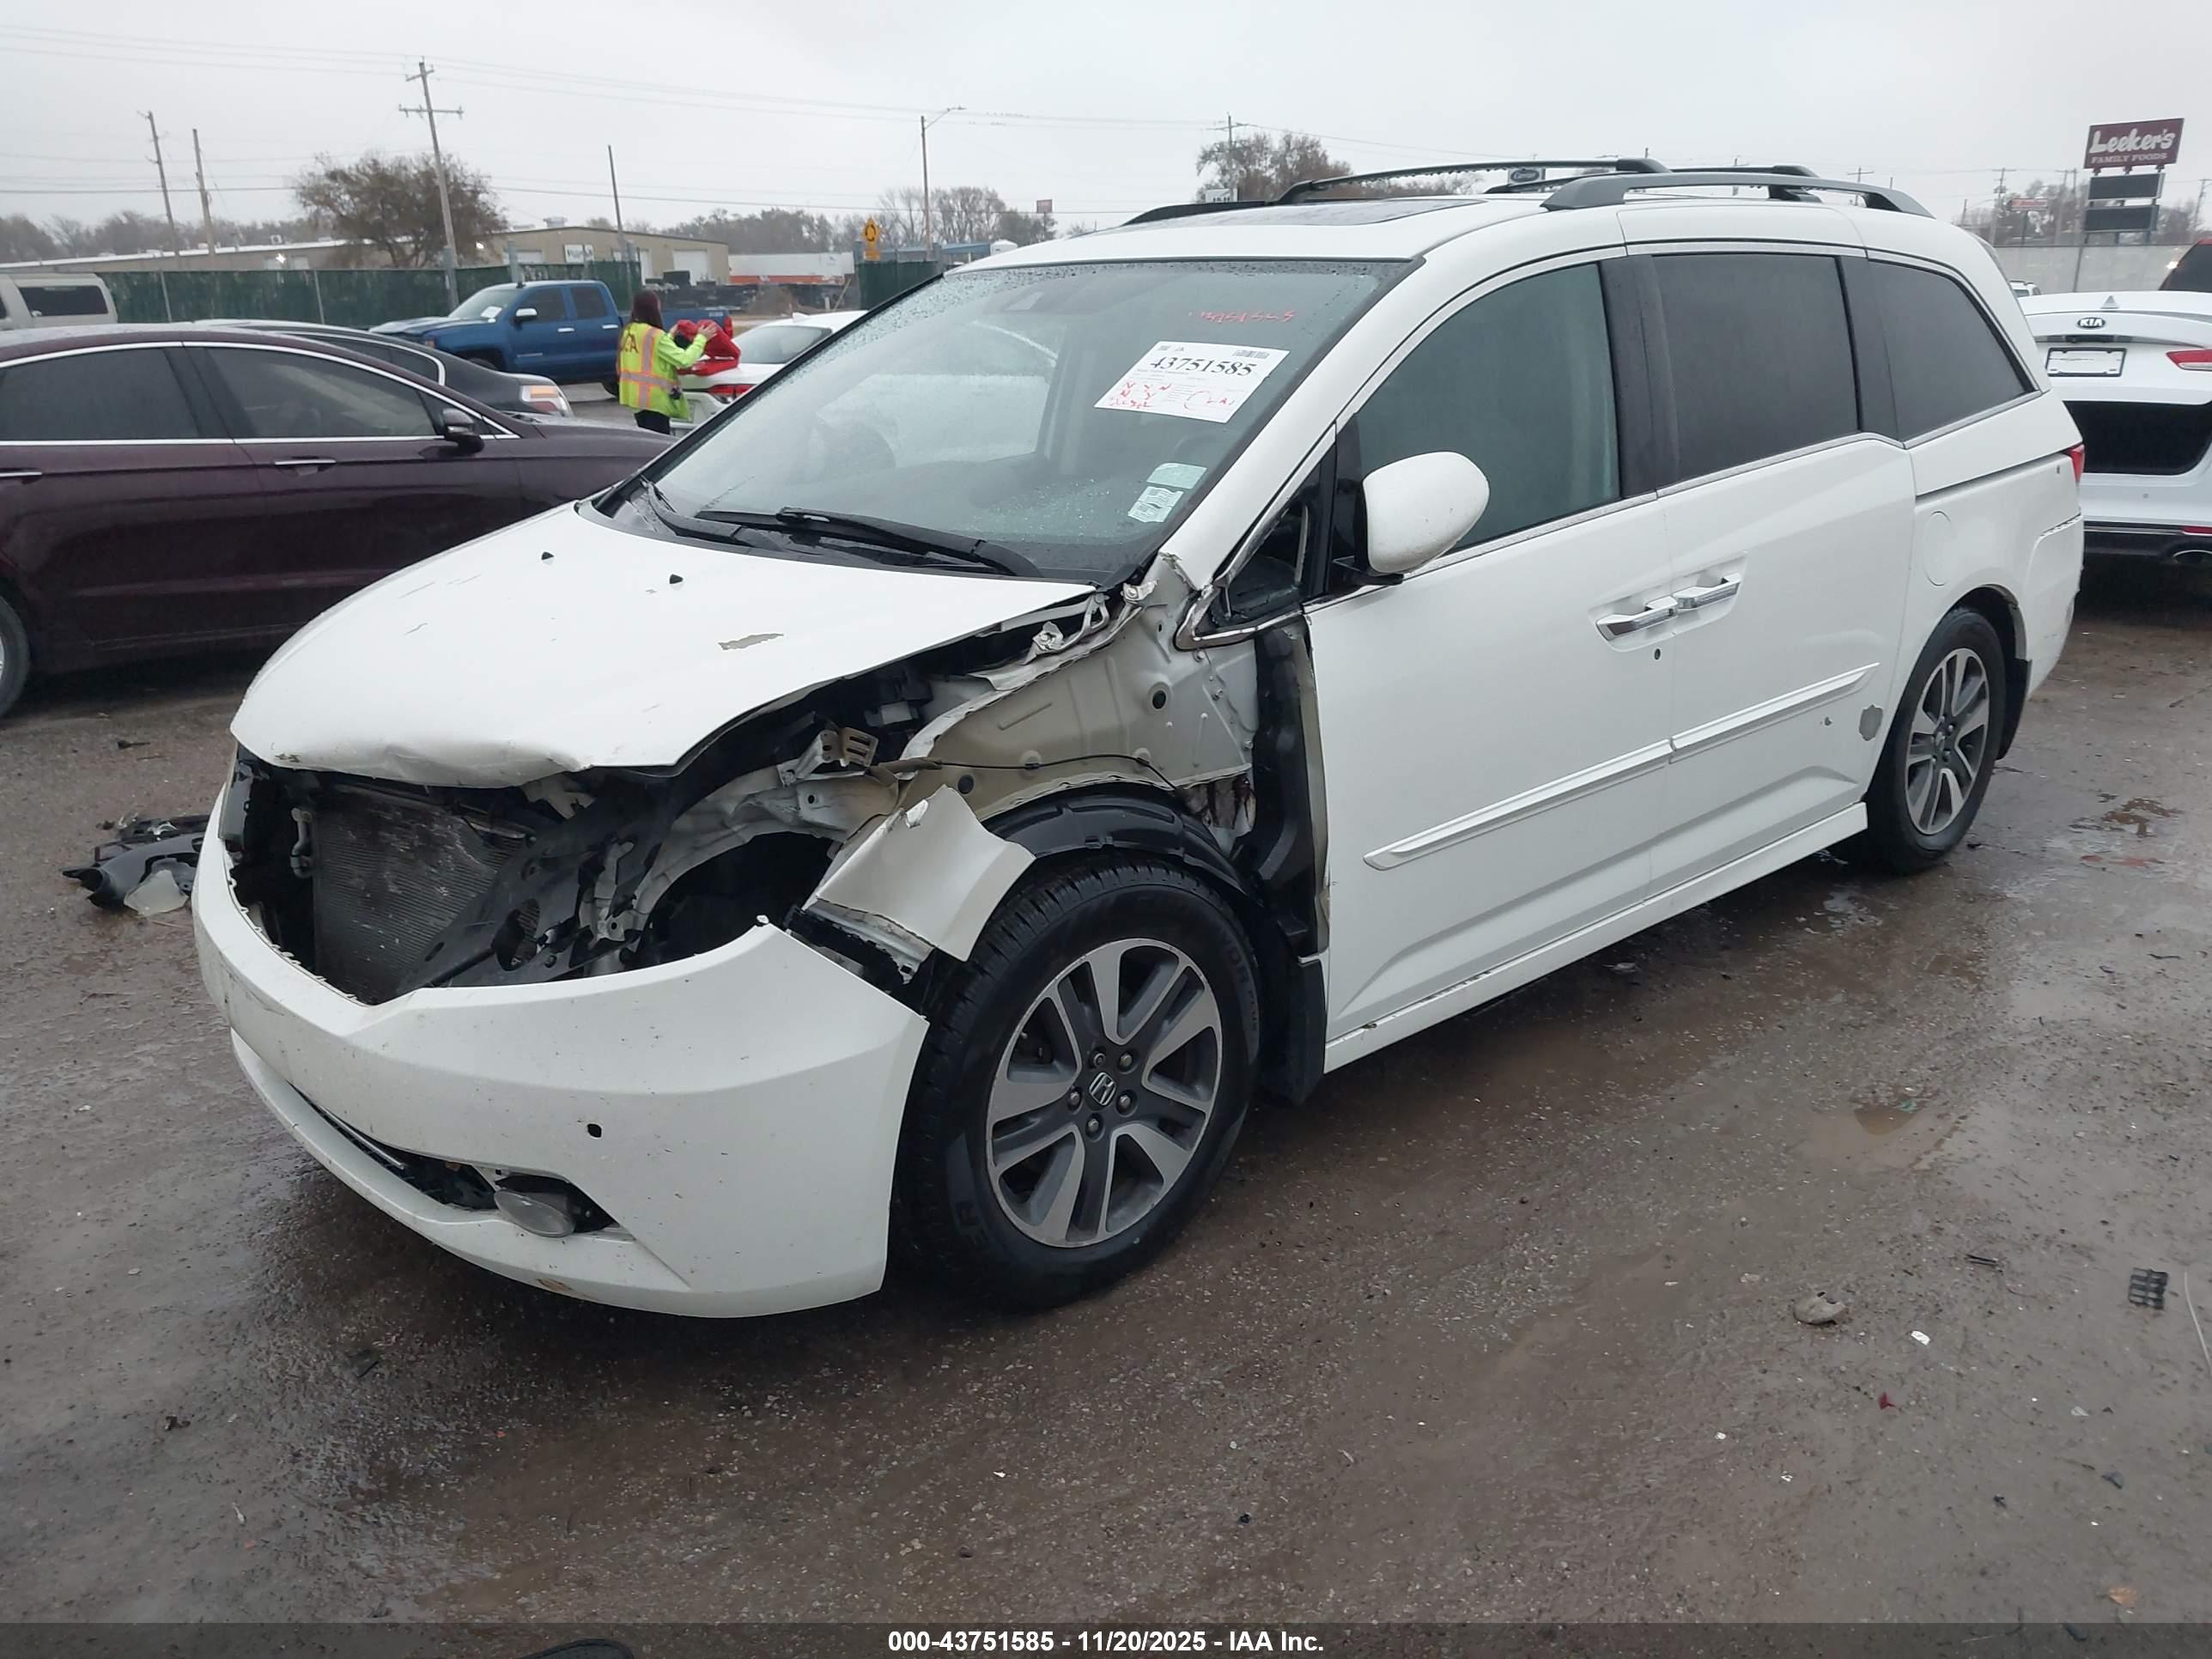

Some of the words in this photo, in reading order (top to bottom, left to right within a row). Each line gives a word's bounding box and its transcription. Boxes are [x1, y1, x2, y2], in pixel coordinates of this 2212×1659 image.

[2089, 128, 2175, 154] Leeker's
[2091, 155, 2130, 164] FAMILY
[2132, 152, 2167, 161] FOODS
[2079, 319, 2103, 327] KIA
[1150, 356, 1257, 376] 43751585
